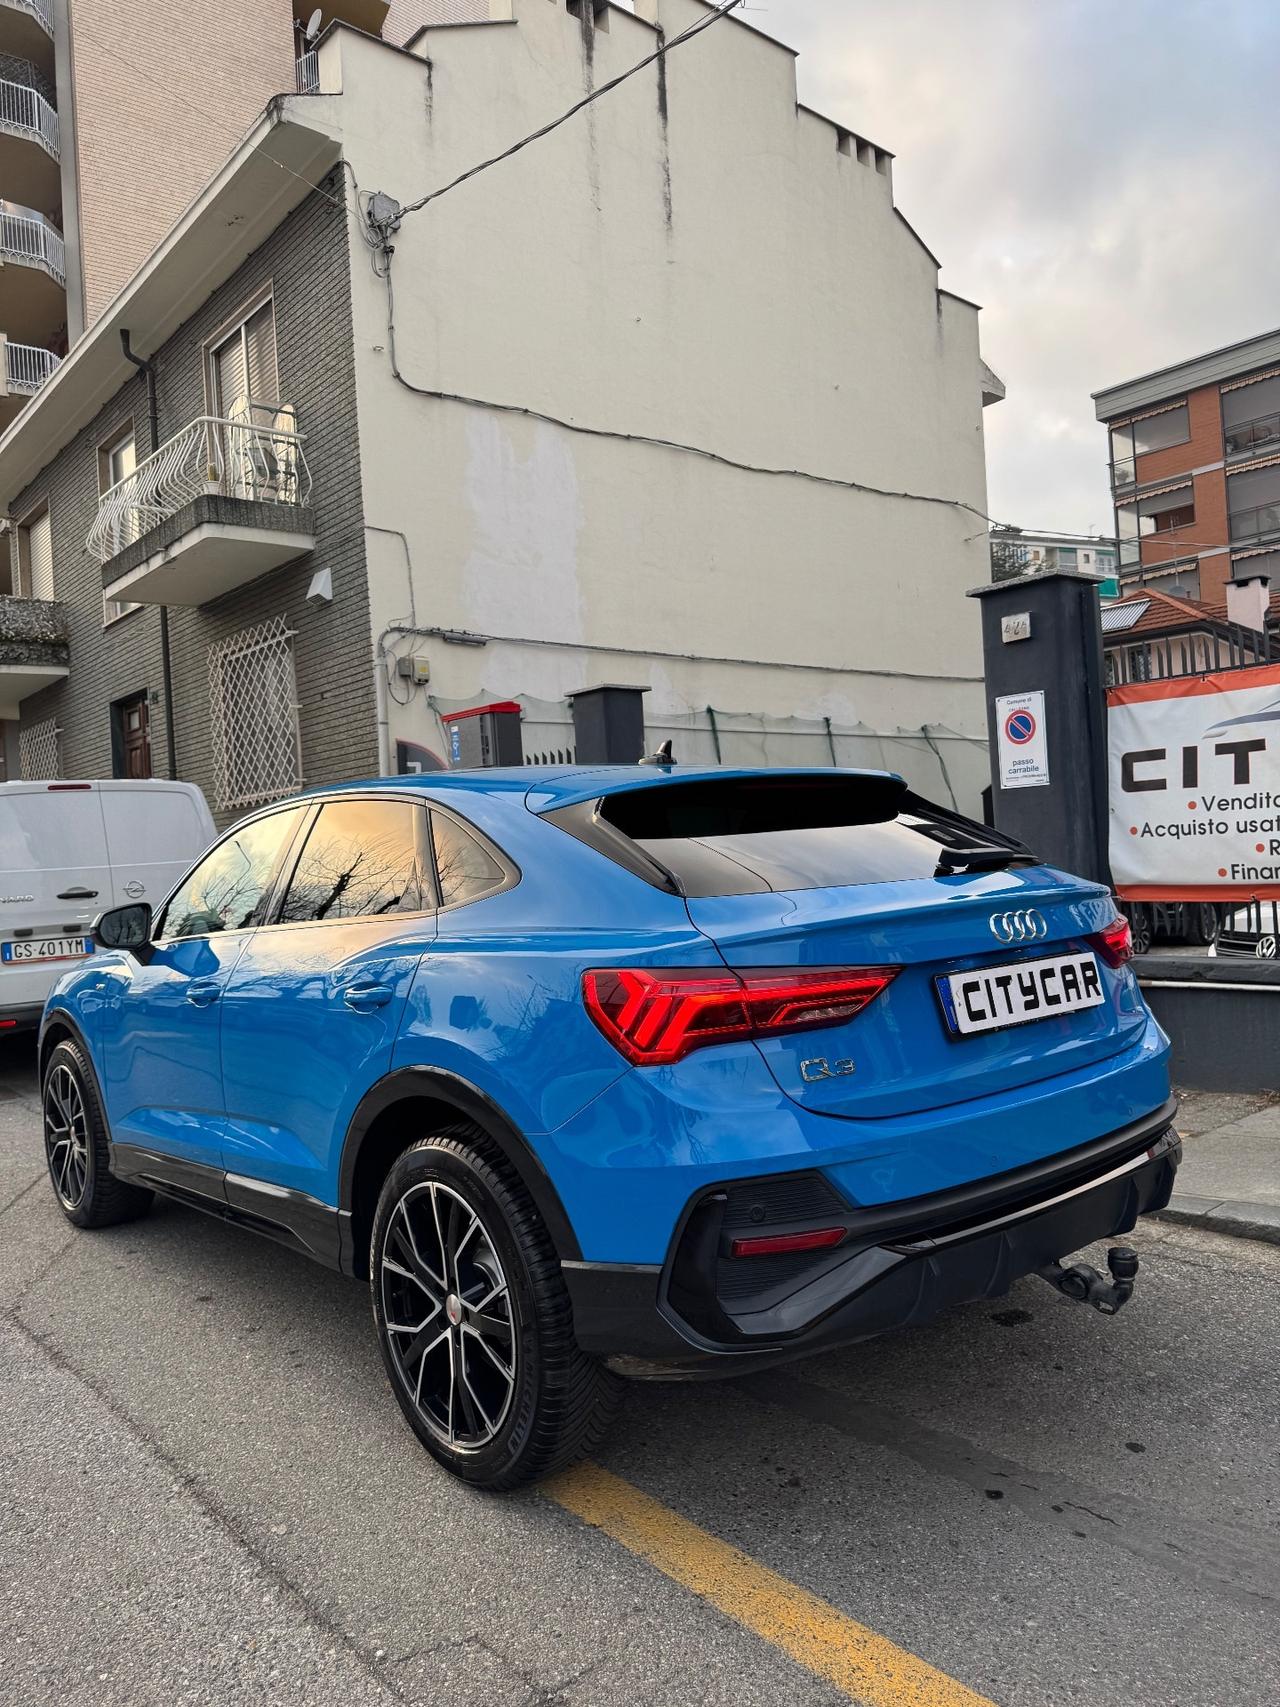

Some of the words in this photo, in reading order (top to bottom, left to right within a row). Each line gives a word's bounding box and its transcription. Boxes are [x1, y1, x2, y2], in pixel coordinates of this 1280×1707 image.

[1008, 765, 1040, 774] carrabile
[1012, 758, 1034, 767] passo
[1121, 738, 1266, 793] CIT
[1140, 819, 1229, 840] Acquisto
[962, 961, 1102, 1023] CITYCAR
[800, 1058, 855, 1082] Q3
